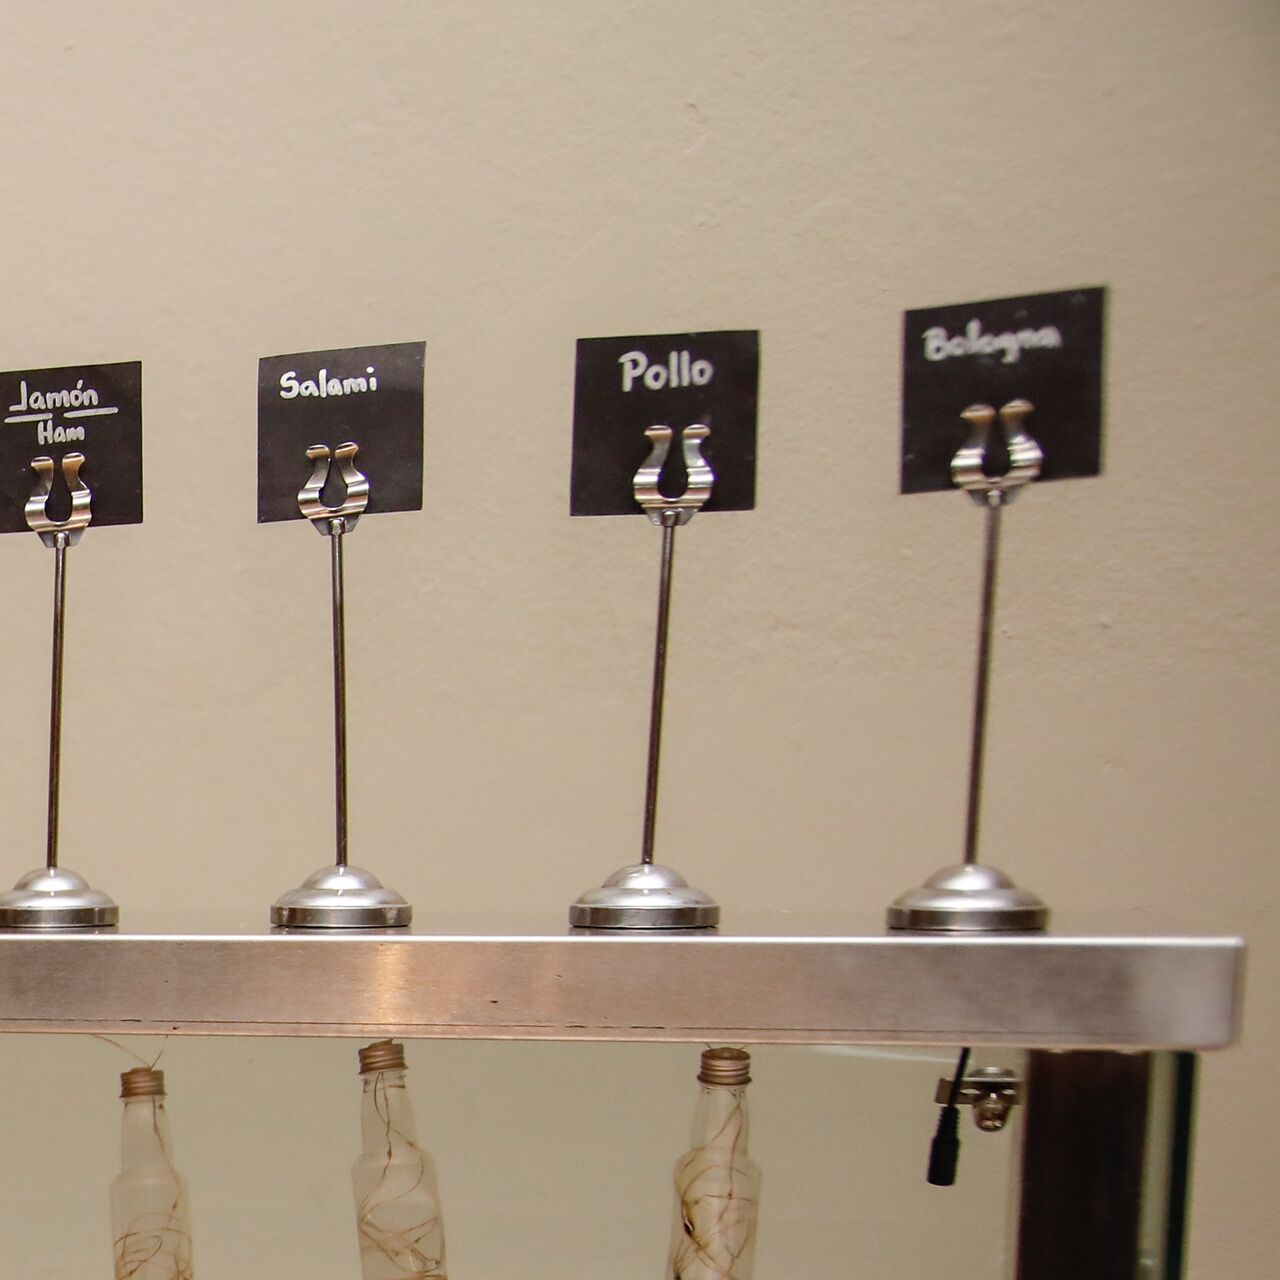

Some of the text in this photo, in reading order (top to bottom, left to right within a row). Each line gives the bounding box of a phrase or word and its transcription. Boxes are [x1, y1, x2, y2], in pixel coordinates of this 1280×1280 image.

[923, 318, 1061, 363] Bologna
[279, 367, 377, 399] Salami
[618, 350, 714, 393] Pollo
[9, 379, 99, 412] Jamón
[37, 421, 85, 445] Ham
